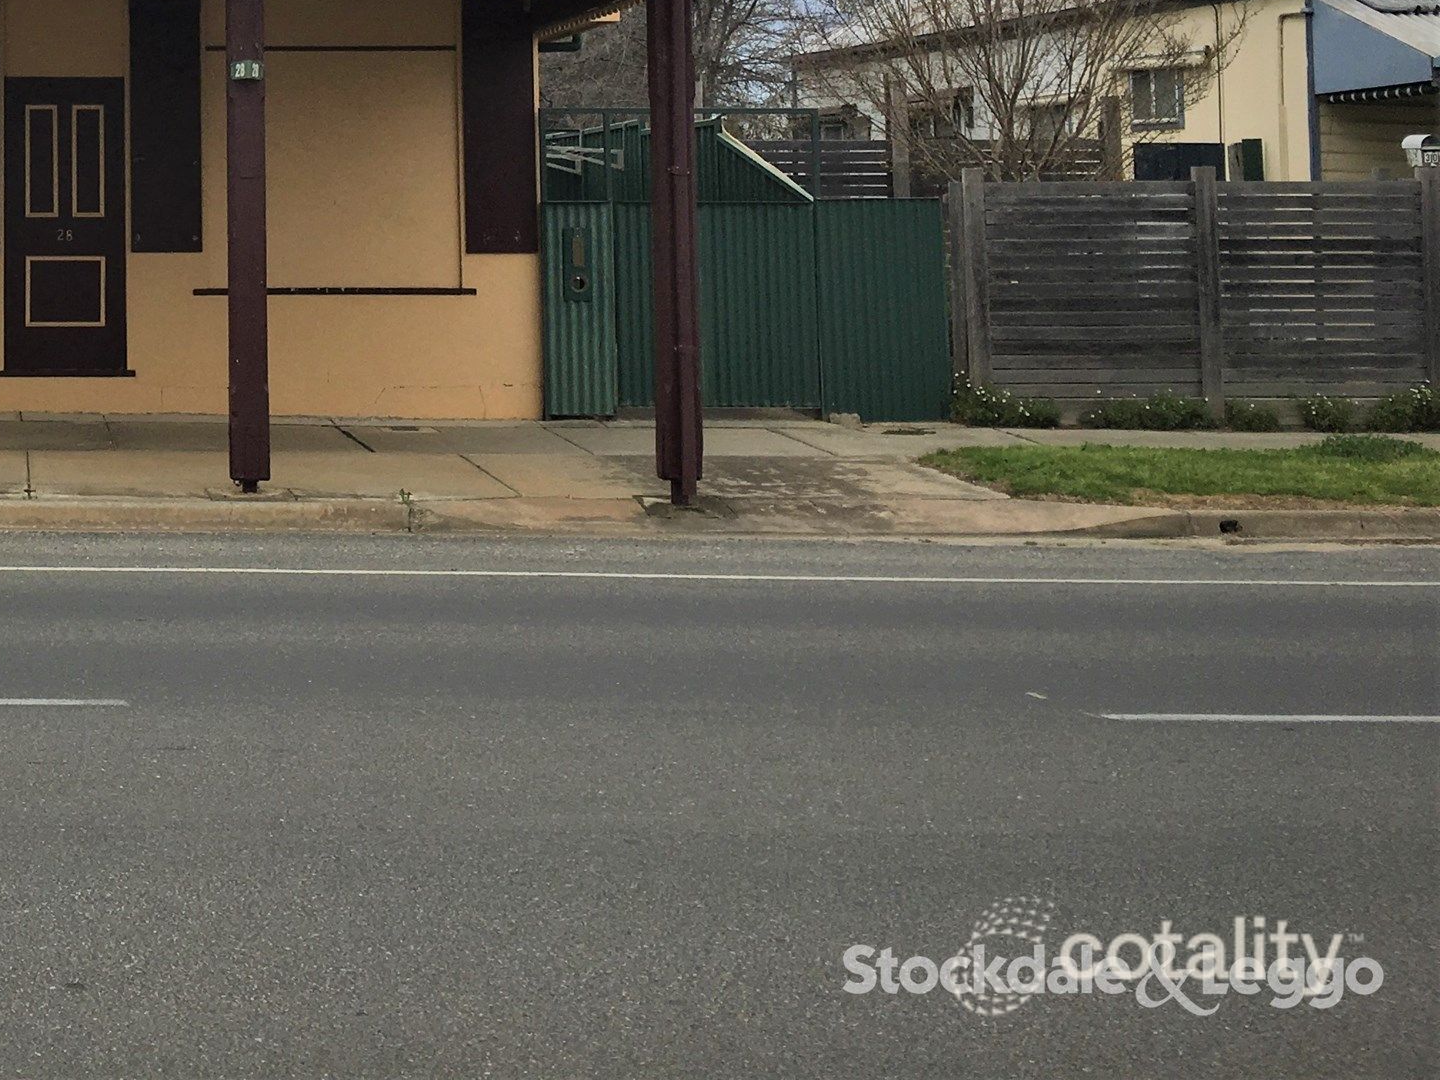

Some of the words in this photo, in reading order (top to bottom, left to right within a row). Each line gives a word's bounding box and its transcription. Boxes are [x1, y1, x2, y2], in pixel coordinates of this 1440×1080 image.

[235, 62, 245, 78] 28
[1425, 153, 1438, 162] 30
[57, 229, 73, 241] 28
